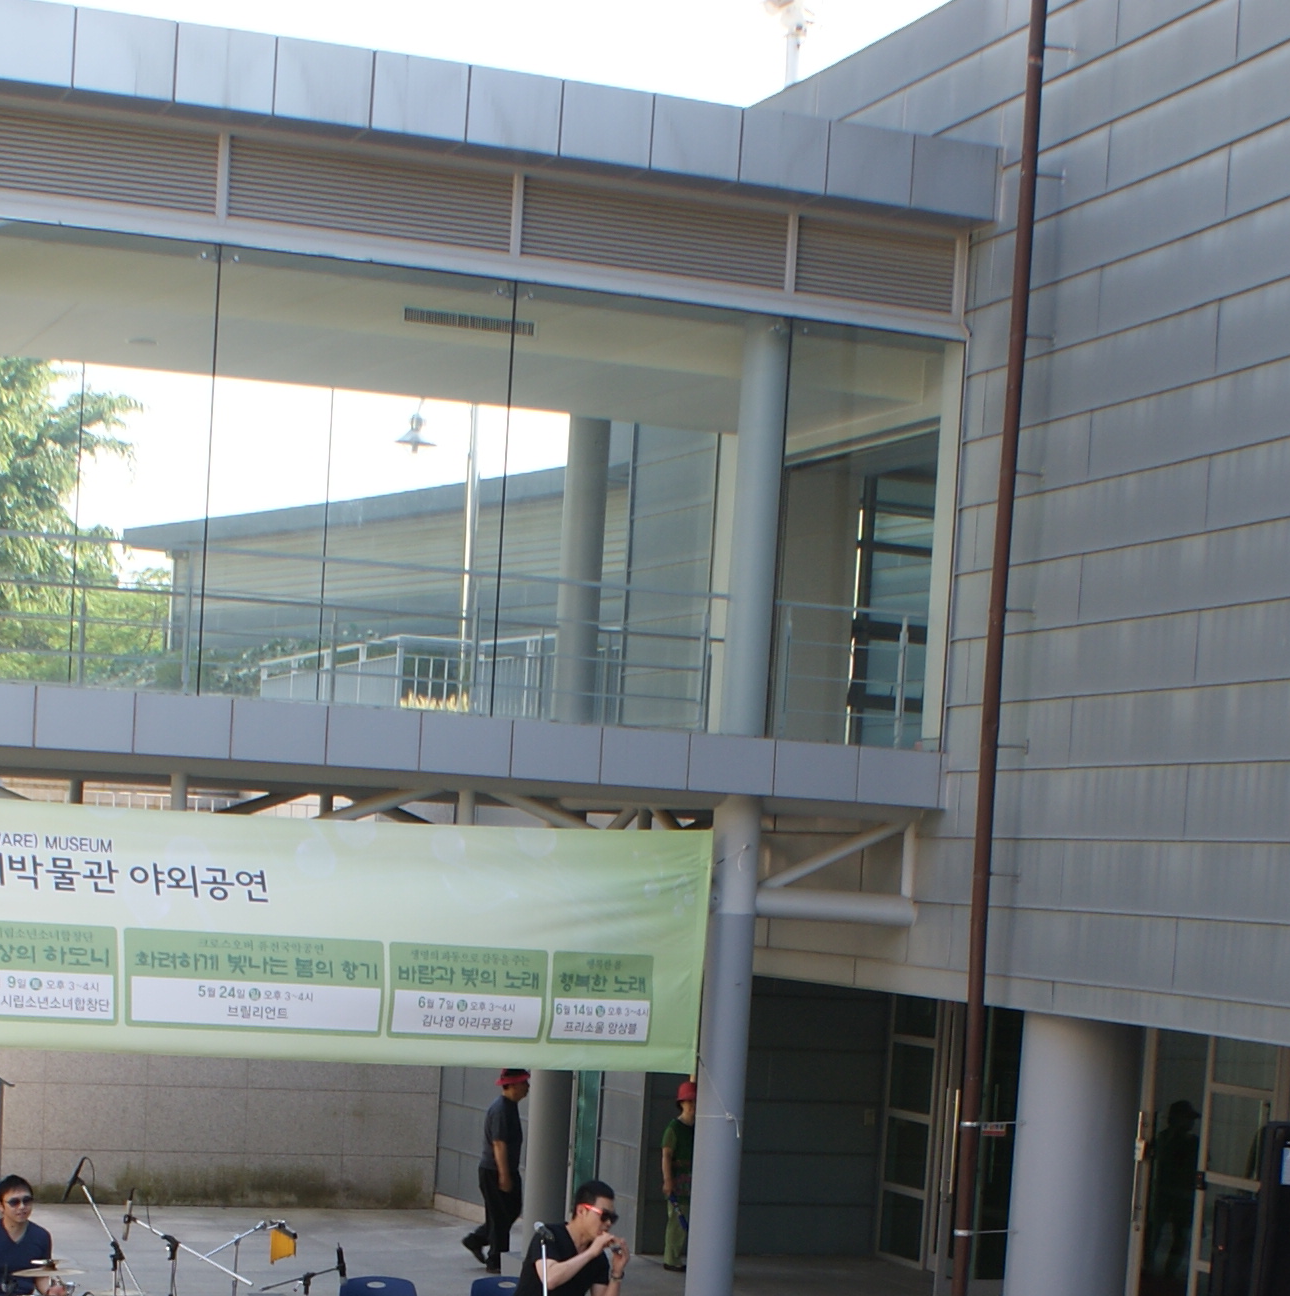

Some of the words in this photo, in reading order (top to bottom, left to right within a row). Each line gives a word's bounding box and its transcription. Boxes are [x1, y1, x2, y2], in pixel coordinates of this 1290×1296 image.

[45, 835, 113, 854] MUSEUM
[129, 862, 269, 903] 야외공연
[43, 945, 110, 968] 하모니
[134, 950, 219, 972] 화려하게
[227, 953, 288, 975] 빛나는
[294, 957, 334, 979] 봄의
[341, 960, 378, 981] 향기
[398, 964, 456, 986] 바람과
[461, 966, 497, 988] 빛의
[504, 970, 540, 990] 노래
[559, 972, 608, 993] 행복한
[613, 975, 646, 994] 노래
[227, 1004, 288, 1020] 브릴리언트
